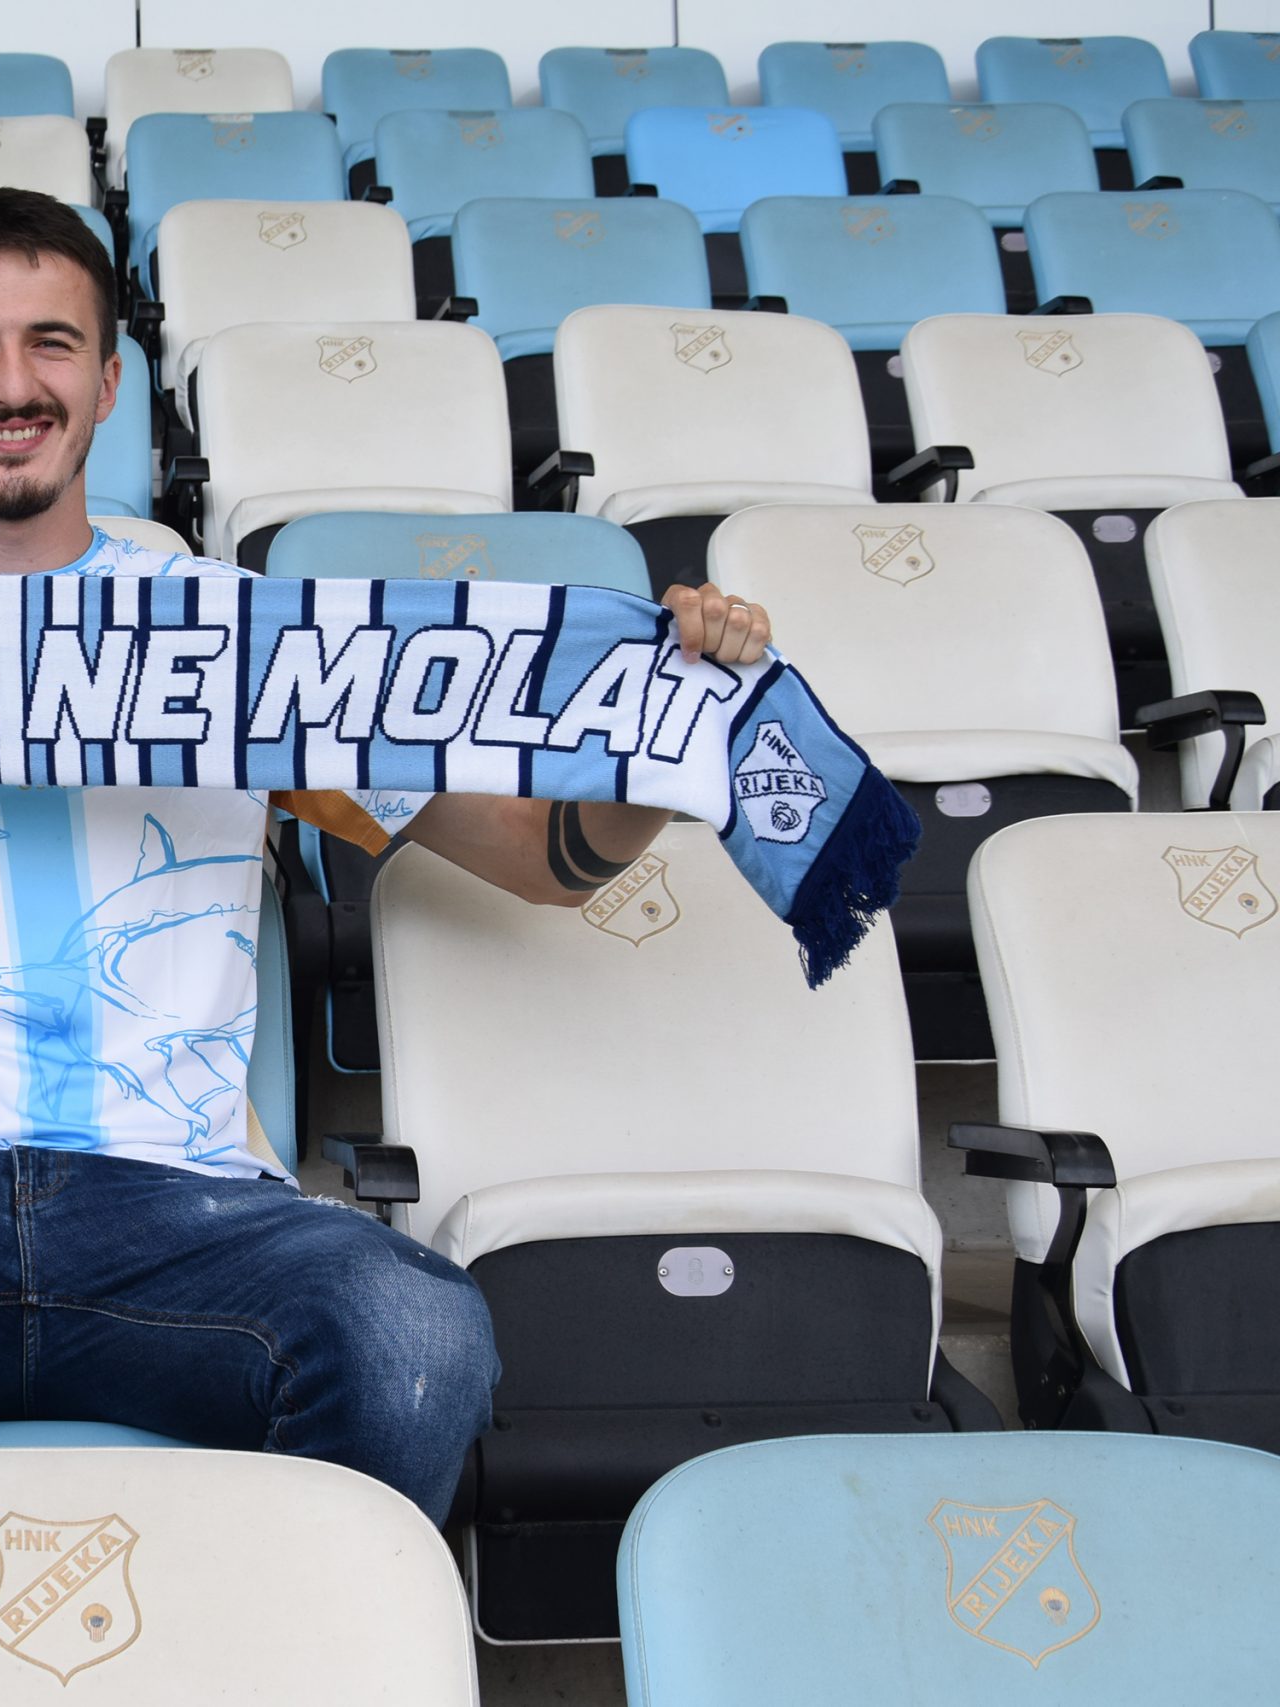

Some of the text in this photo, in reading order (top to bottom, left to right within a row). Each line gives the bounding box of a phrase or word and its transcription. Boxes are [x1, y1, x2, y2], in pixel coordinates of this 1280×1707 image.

[323, 339, 367, 370] RIJEKA
[861, 530, 888, 539] HNK
[869, 530, 917, 569] RIJEKA
[22, 624, 230, 745] NE
[246, 624, 743, 764] MOLAT
[760, 728, 797, 768] HNK
[740, 773, 822, 796] RIJEKA
[1172, 854, 1212, 867] HNK
[590, 861, 657, 919] RIJEKA
[1191, 855, 1248, 911] RIJEKA
[4, 1528, 62, 1552] HNK
[942, 1514, 1000, 1538] HNK
[1, 1531, 123, 1635] RIJEKA
[962, 1516, 1066, 1619] RIJEKA
